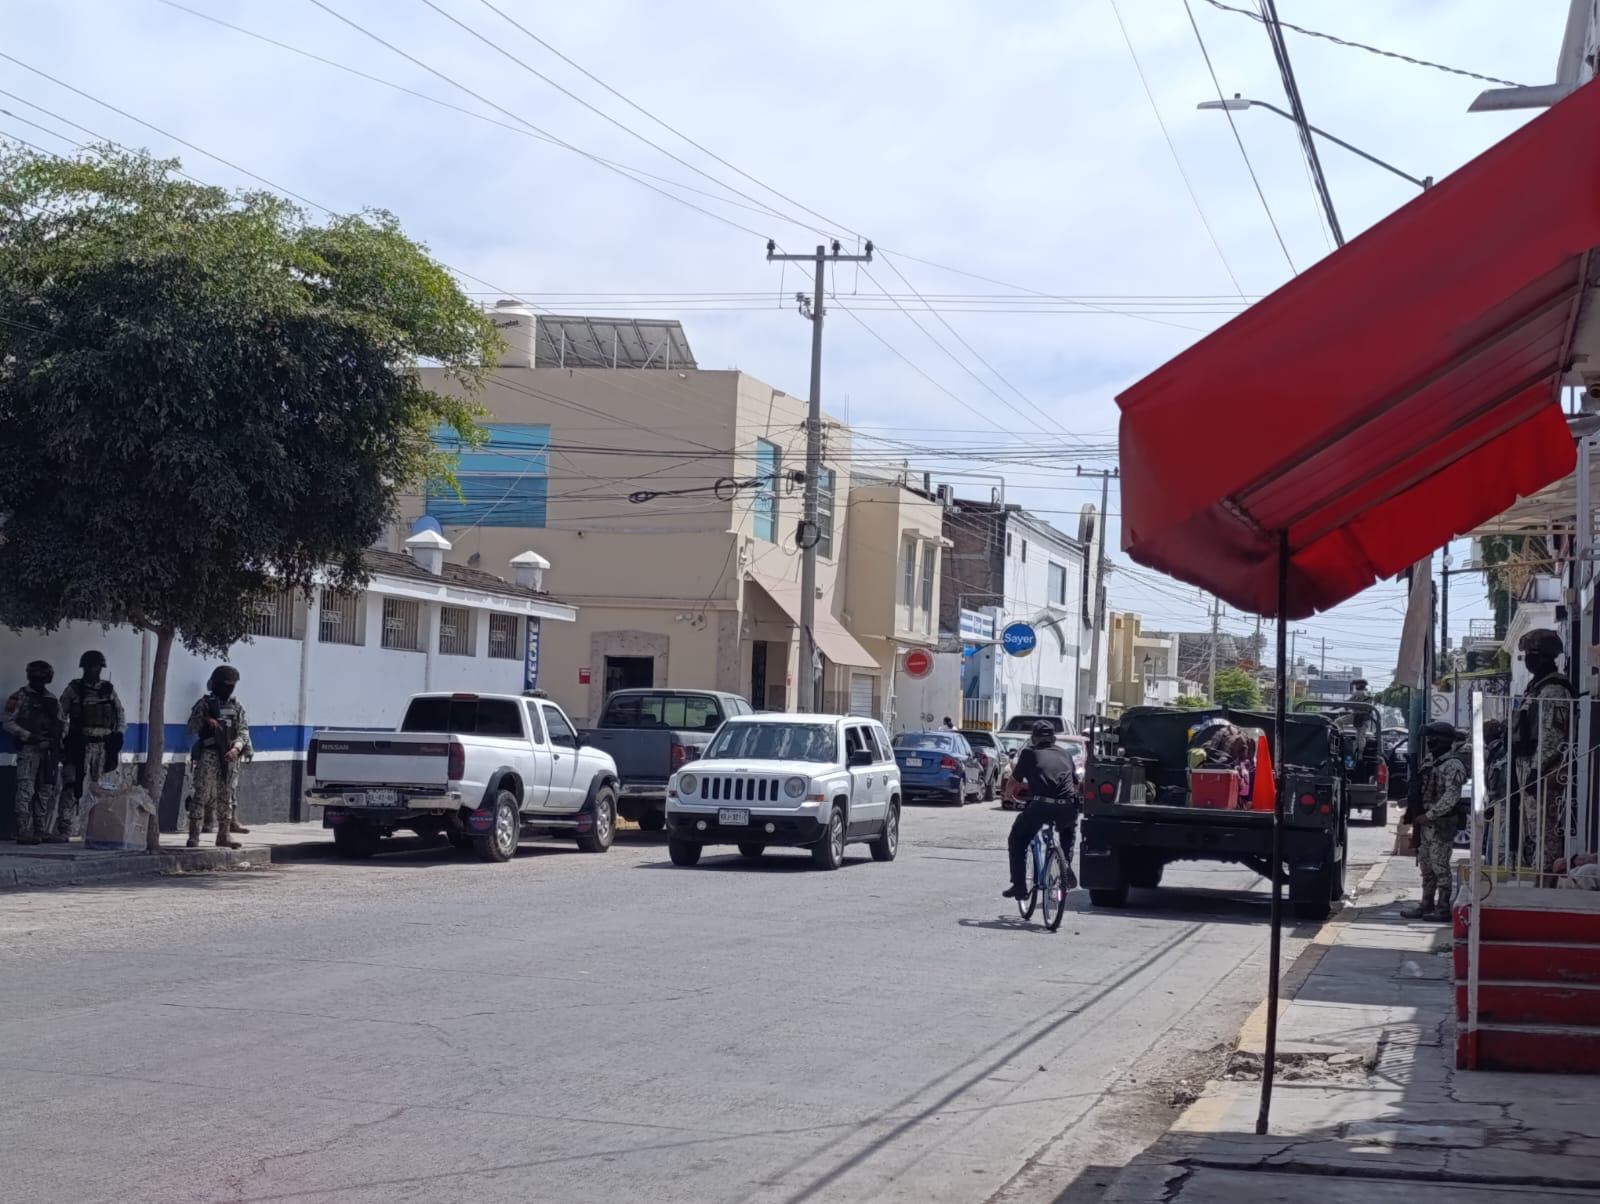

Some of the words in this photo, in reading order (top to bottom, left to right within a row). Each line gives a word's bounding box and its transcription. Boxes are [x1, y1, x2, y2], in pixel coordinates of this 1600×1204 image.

[1005, 633, 1033, 646] Sayer
[528, 621, 539, 682] TECATE
[321, 743, 350, 751] NISSAN
